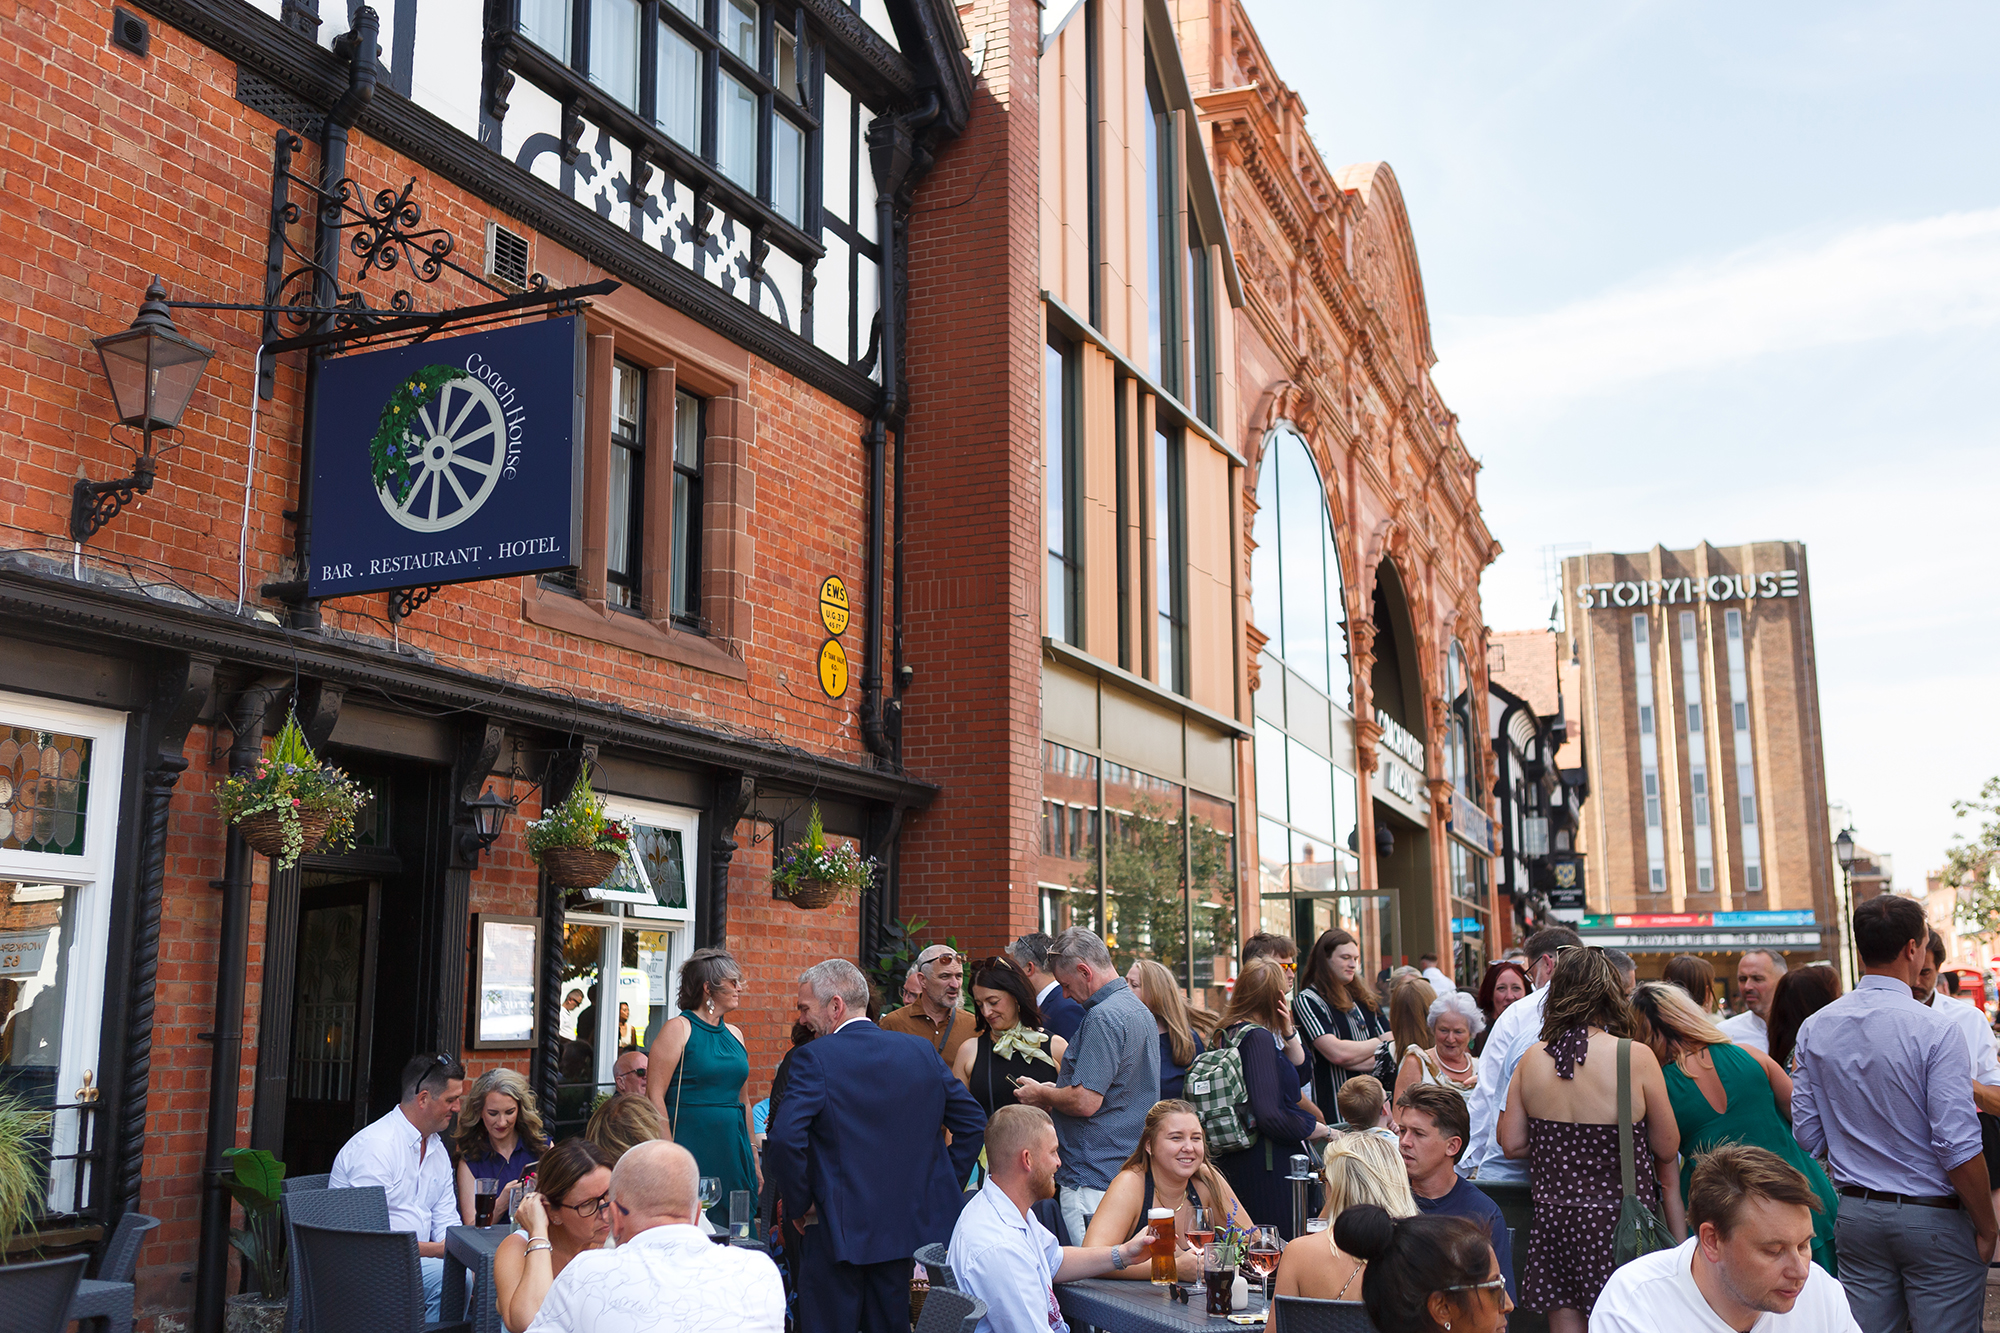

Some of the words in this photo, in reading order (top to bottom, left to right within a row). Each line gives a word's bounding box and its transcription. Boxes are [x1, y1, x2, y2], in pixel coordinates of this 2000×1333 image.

[465, 352, 516, 408] Coach
[502, 405, 526, 481] House
[321, 563, 353, 581] BAR
[369, 546, 483, 575] RESTAURANT
[499, 536, 560, 559] HOTEL
[1576, 570, 1800, 609] STORYHOUSE
[1637, 935, 1679, 946] PRIVATE
[1686, 934, 1705, 945] LIFE
